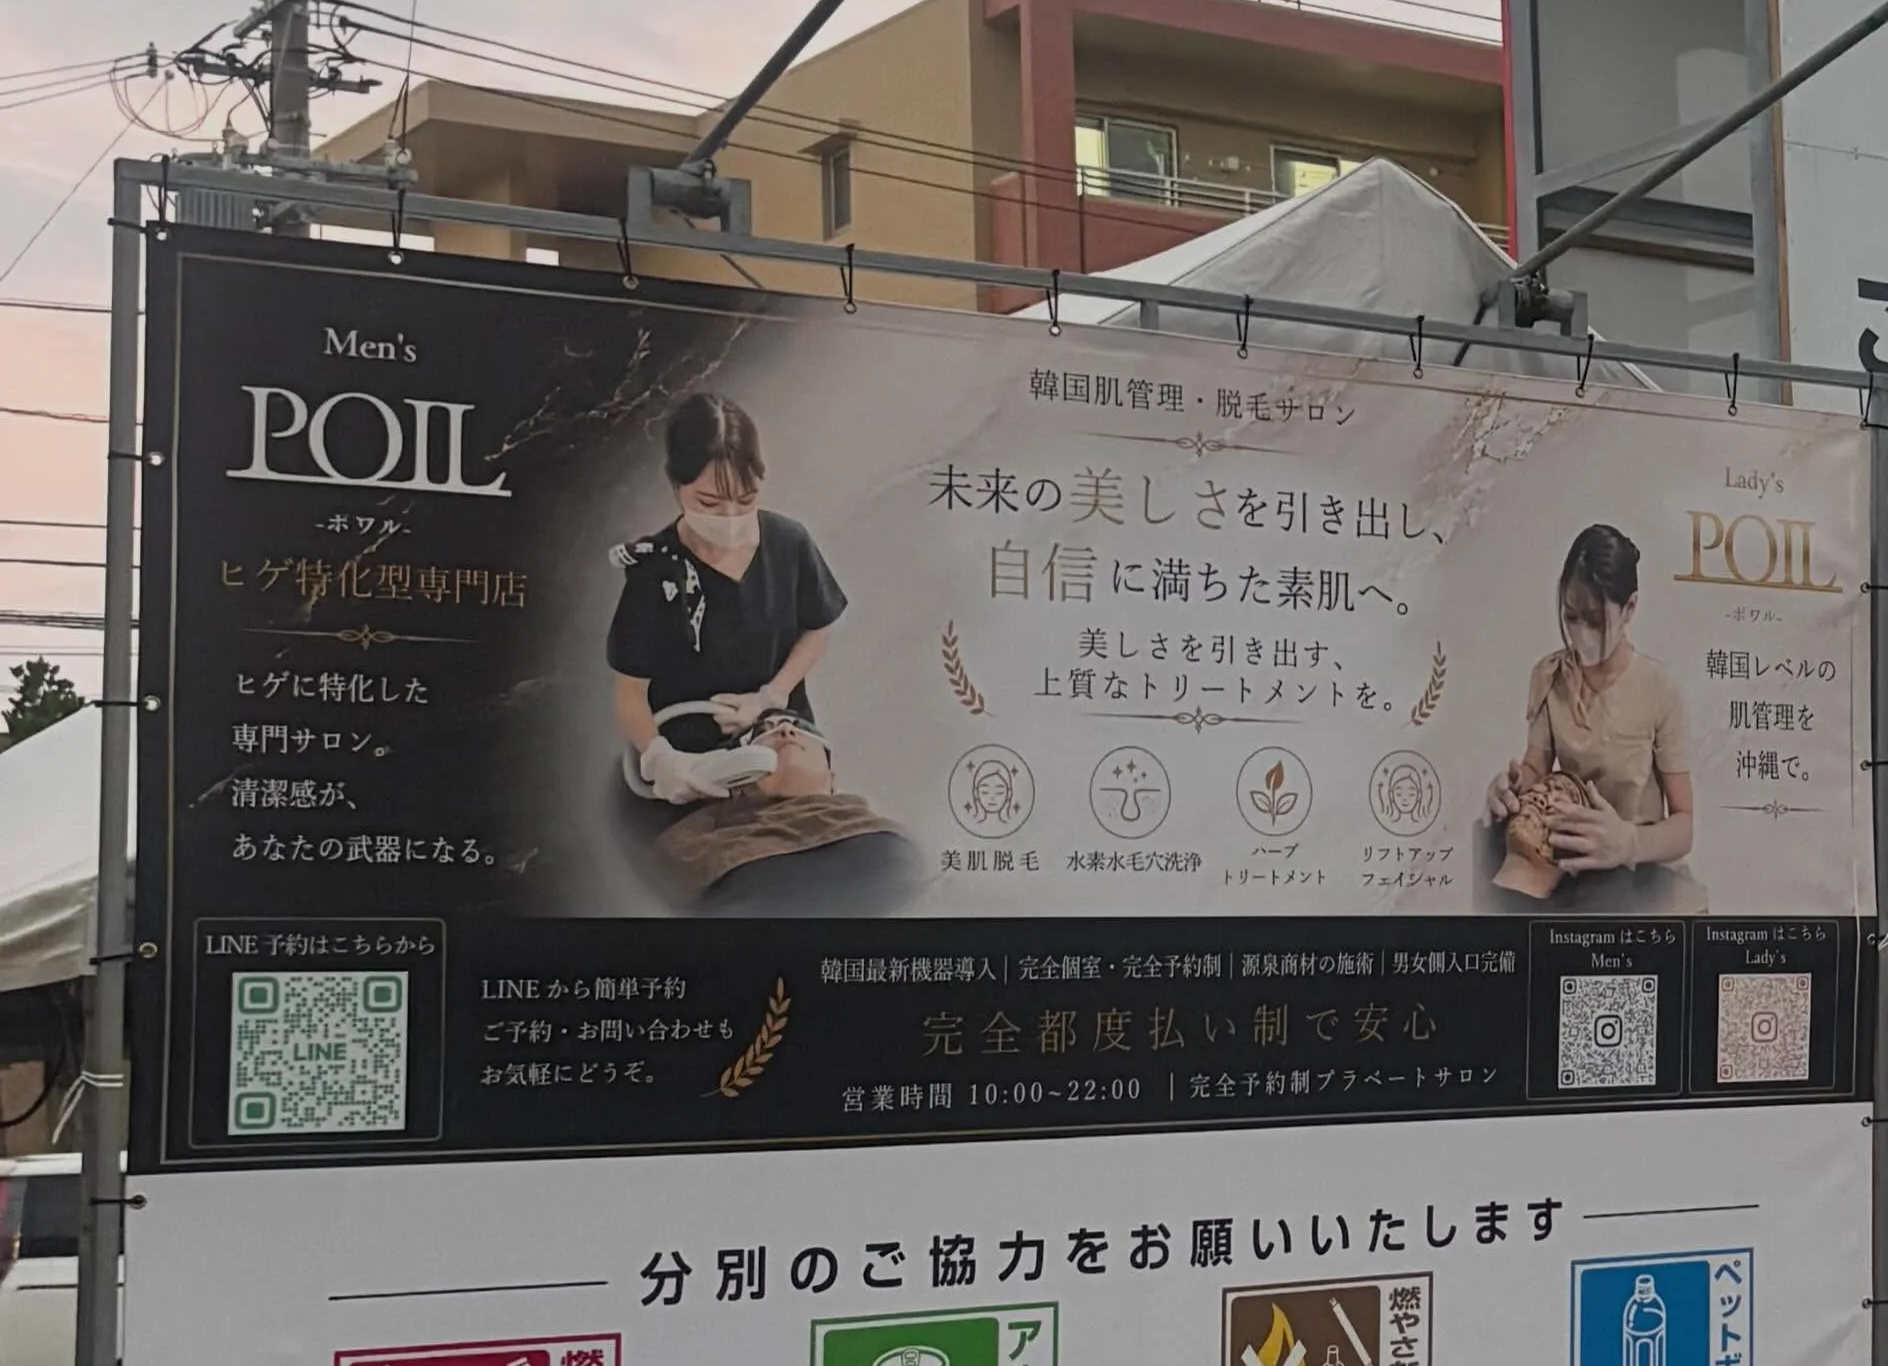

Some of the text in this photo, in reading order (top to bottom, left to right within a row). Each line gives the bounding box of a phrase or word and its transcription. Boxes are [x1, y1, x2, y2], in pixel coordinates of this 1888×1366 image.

[323, 327, 417, 364] Men's
[1029, 368, 1356, 427] 韓国肌管理・脱毛サロン
[225, 384, 512, 498] POIL
[1724, 466, 1785, 497] Lady's
[928, 464, 1448, 545] 未来の美しさを引き出し、
[1673, 510, 1843, 593] POIL
[219, 558, 528, 609] ヒゲ特化型専門店
[1078, 627, 1345, 671] 美しさを引き出す、
[1706, 649, 1836, 683] 韓国レベルの
[235, 671, 430, 706] ヒゲに特化した
[1033, 667, 1396, 713] 上質なトリートメントを。
[1728, 700, 1815, 733] 肌管理を
[231, 723, 389, 758] 専門サロン。
[1736, 749, 1810, 783] 沖縄で。
[231, 778, 361, 811] 清潔感が、
[231, 833, 499, 867] あなたの武器になる。
[940, 849, 1040, 873] 美肌脱毛
[206, 934, 258, 956] LINE
[1549, 926, 1676, 948] Instagram はこちら
[1705, 924, 1772, 946] Instagram
[1591, 951, 1633, 970] Men's
[1745, 947, 1787, 968] Lady's
[481, 977, 686, 1000] LINE から簡単予約
[922, 1003, 1438, 1058] 完全都度払い制で安心
[293, 1042, 346, 1062] LINE
[842, 1082, 953, 1113] 営業時間
[640, 1197, 1563, 1306] 分別のご協力をお願いいたします
